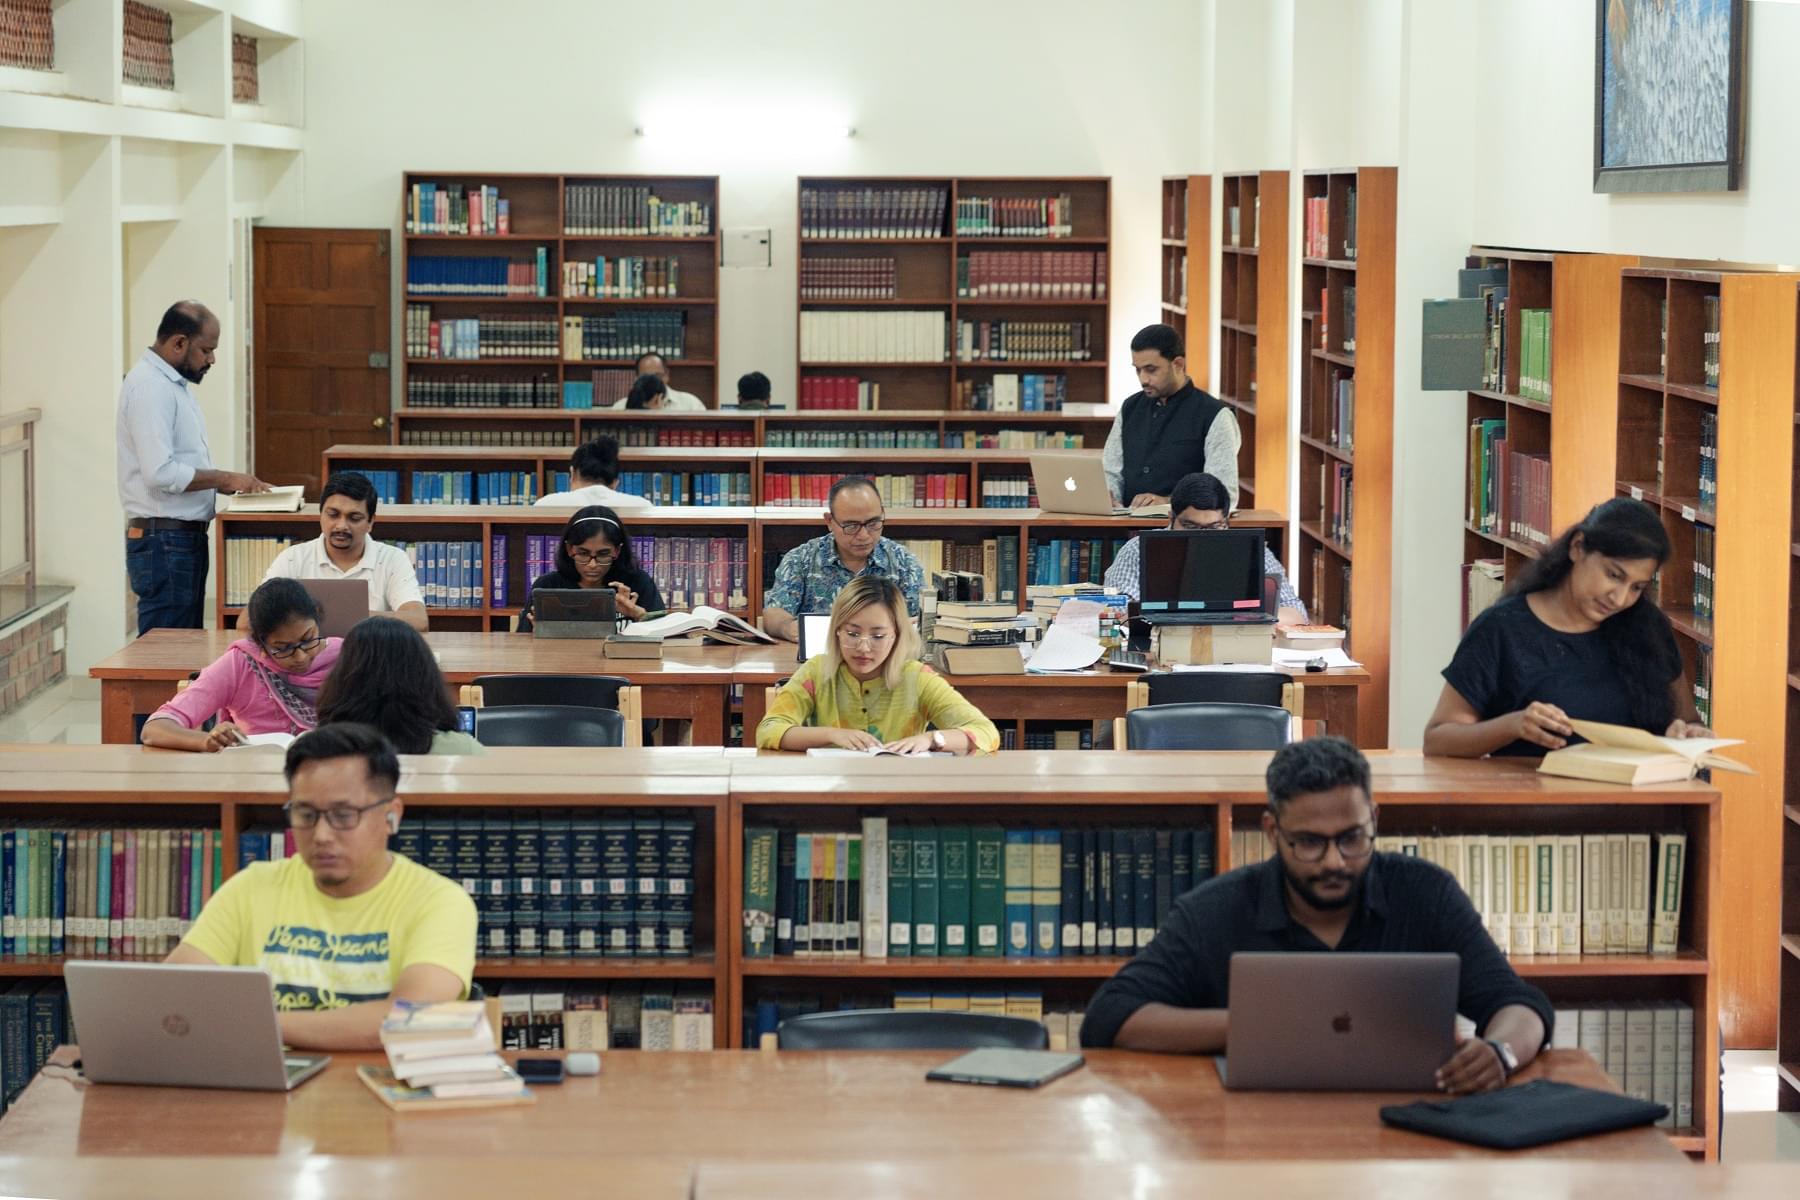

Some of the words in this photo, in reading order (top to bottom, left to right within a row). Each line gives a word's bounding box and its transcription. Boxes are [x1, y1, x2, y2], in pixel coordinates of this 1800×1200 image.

[750, 838, 760, 896] THEOLOGY
[266, 926, 321, 956] Pepe
[274, 990, 315, 1011] epe
